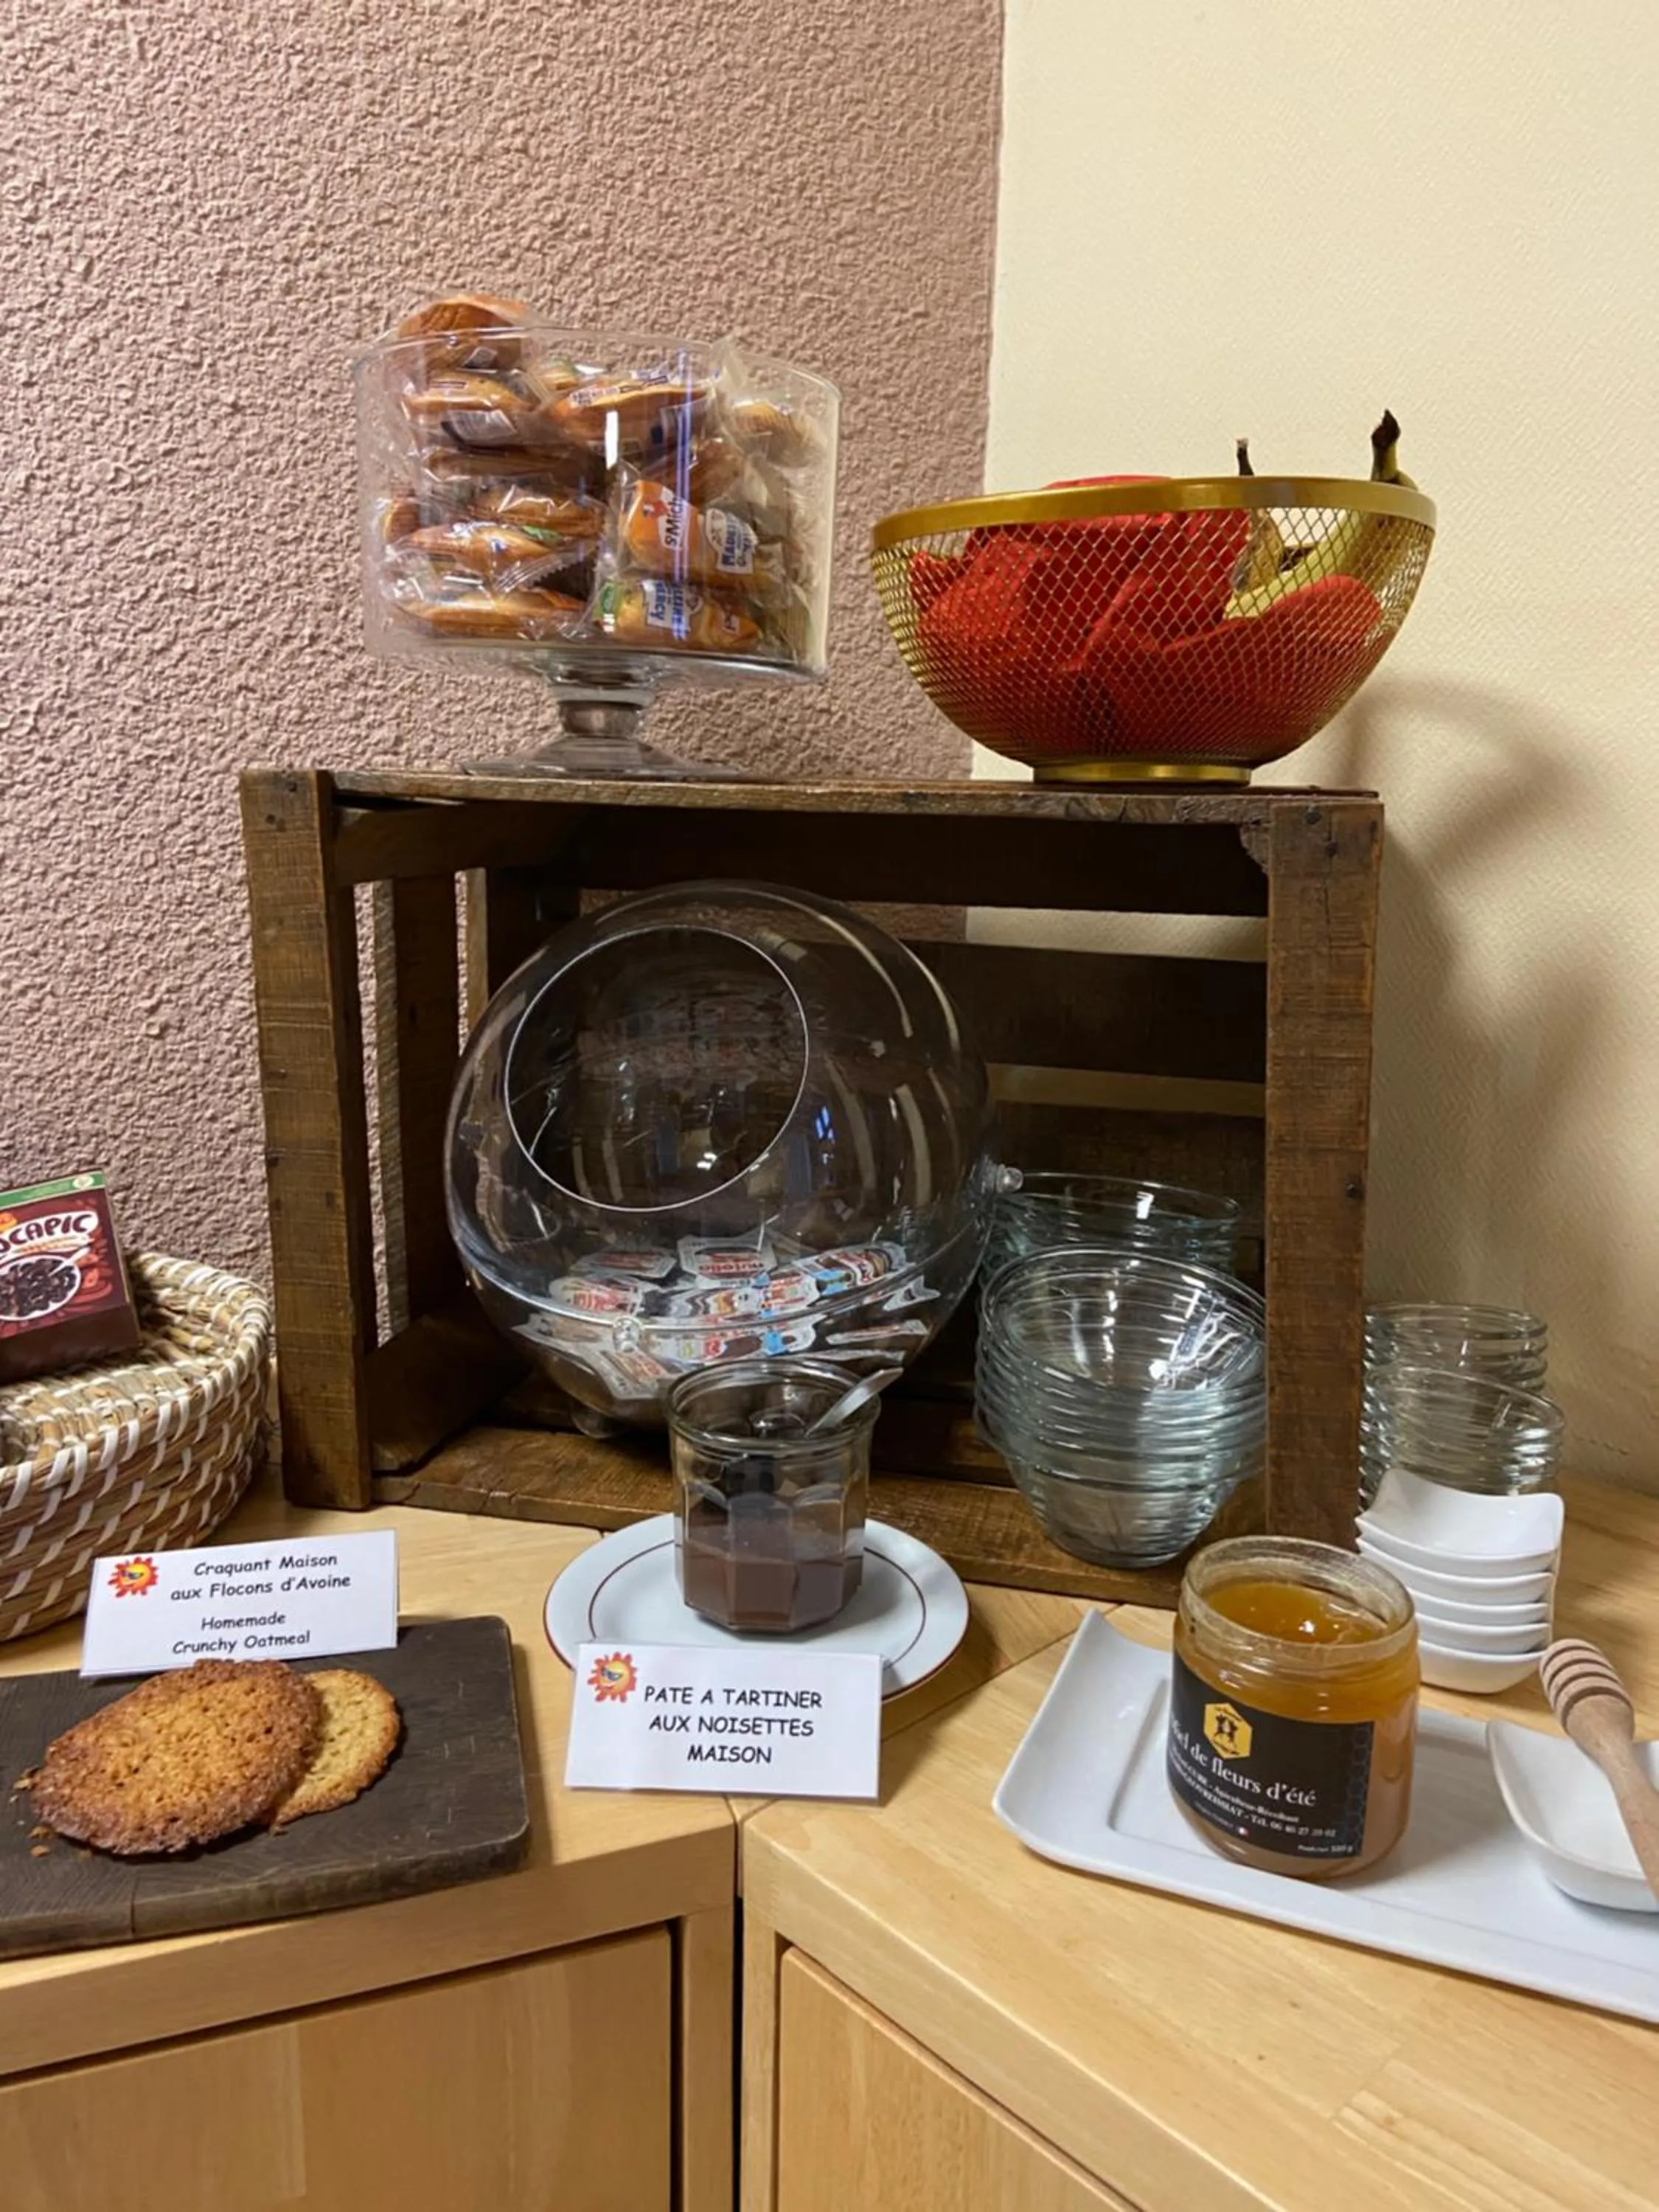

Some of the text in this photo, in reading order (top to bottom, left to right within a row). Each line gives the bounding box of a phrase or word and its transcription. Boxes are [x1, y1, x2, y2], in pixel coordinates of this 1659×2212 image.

[194, 1555, 338, 1578] Craquant Maison
[170, 1575, 352, 1601] aux Flocons d'Avoine
[201, 1611, 286, 1630] Homemade
[172, 1630, 310, 1655] Crunchy Oatmeal
[644, 1686, 823, 1708] PATE A TARTINER
[648, 1715, 814, 1736] AUX NOISETTES
[687, 1745, 772, 1764] MAISON
[1190, 1742, 1208, 1767] de
[1211, 1756, 1262, 1794] fleurs
[1266, 1781, 1317, 1806] d'été
